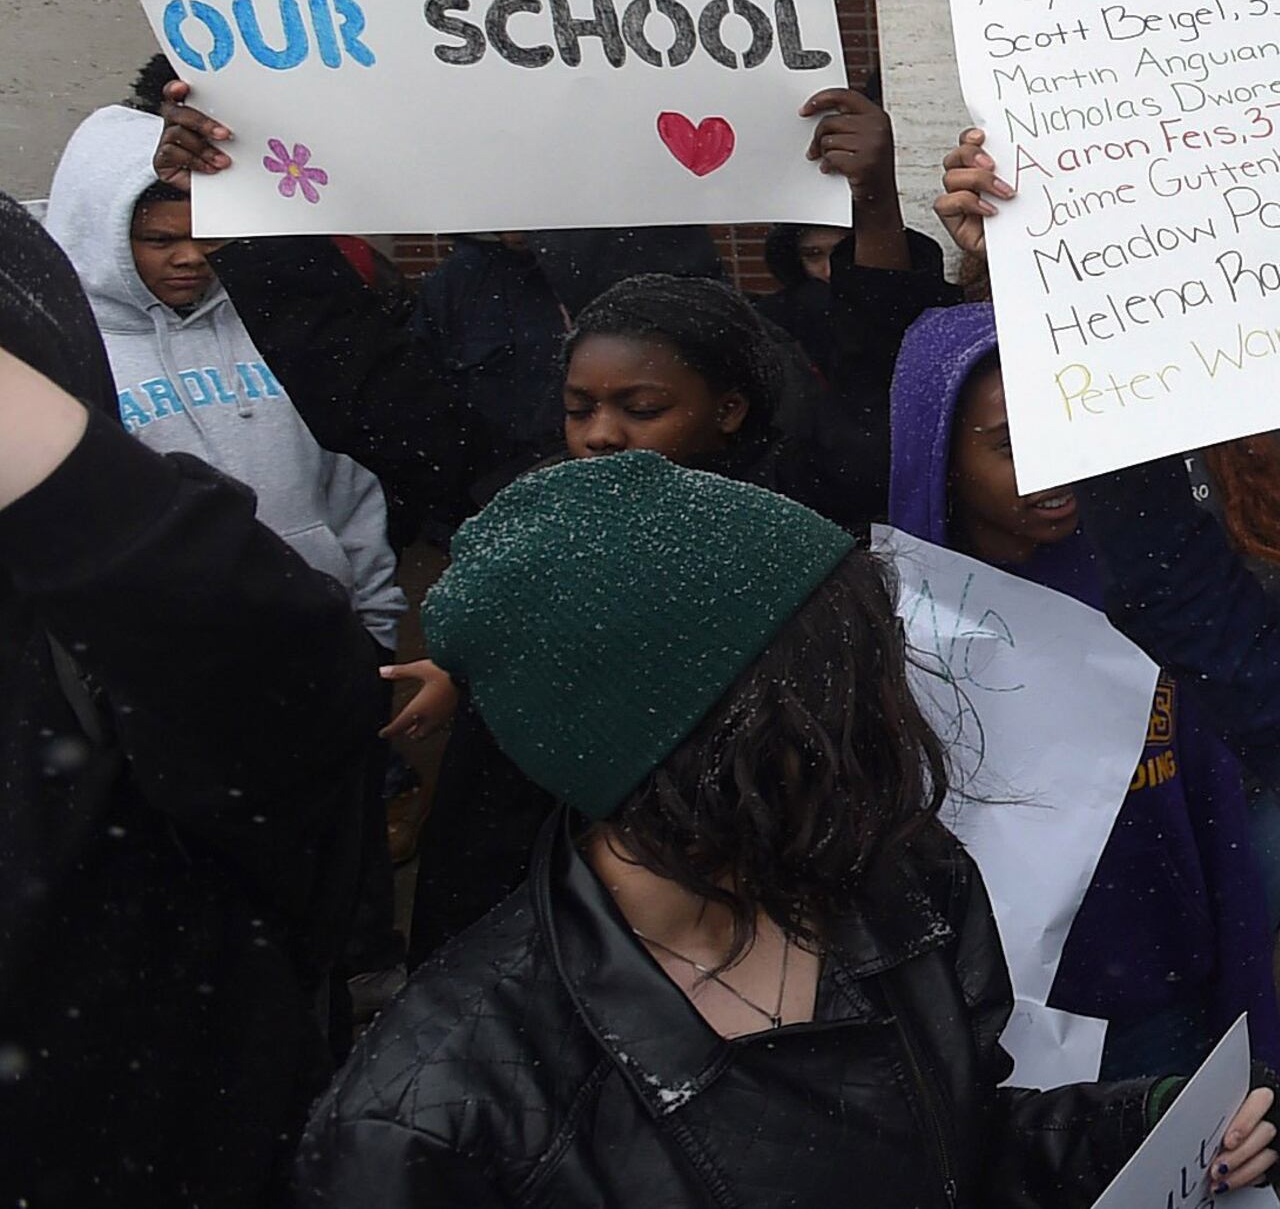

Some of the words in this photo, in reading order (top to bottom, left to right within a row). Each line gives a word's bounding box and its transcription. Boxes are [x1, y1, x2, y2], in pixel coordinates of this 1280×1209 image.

[984, 23, 1090, 59] Scott
[992, 63, 1119, 100] Martin
[1004, 94, 1164, 144] Nicholas
[1013, 136, 1151, 193] Aaron
[1026, 180, 1137, 238] Jaime
[1032, 217, 1218, 295] Meadow
[1045, 277, 1213, 355] Helena
[1052, 363, 1182, 422] Peter
